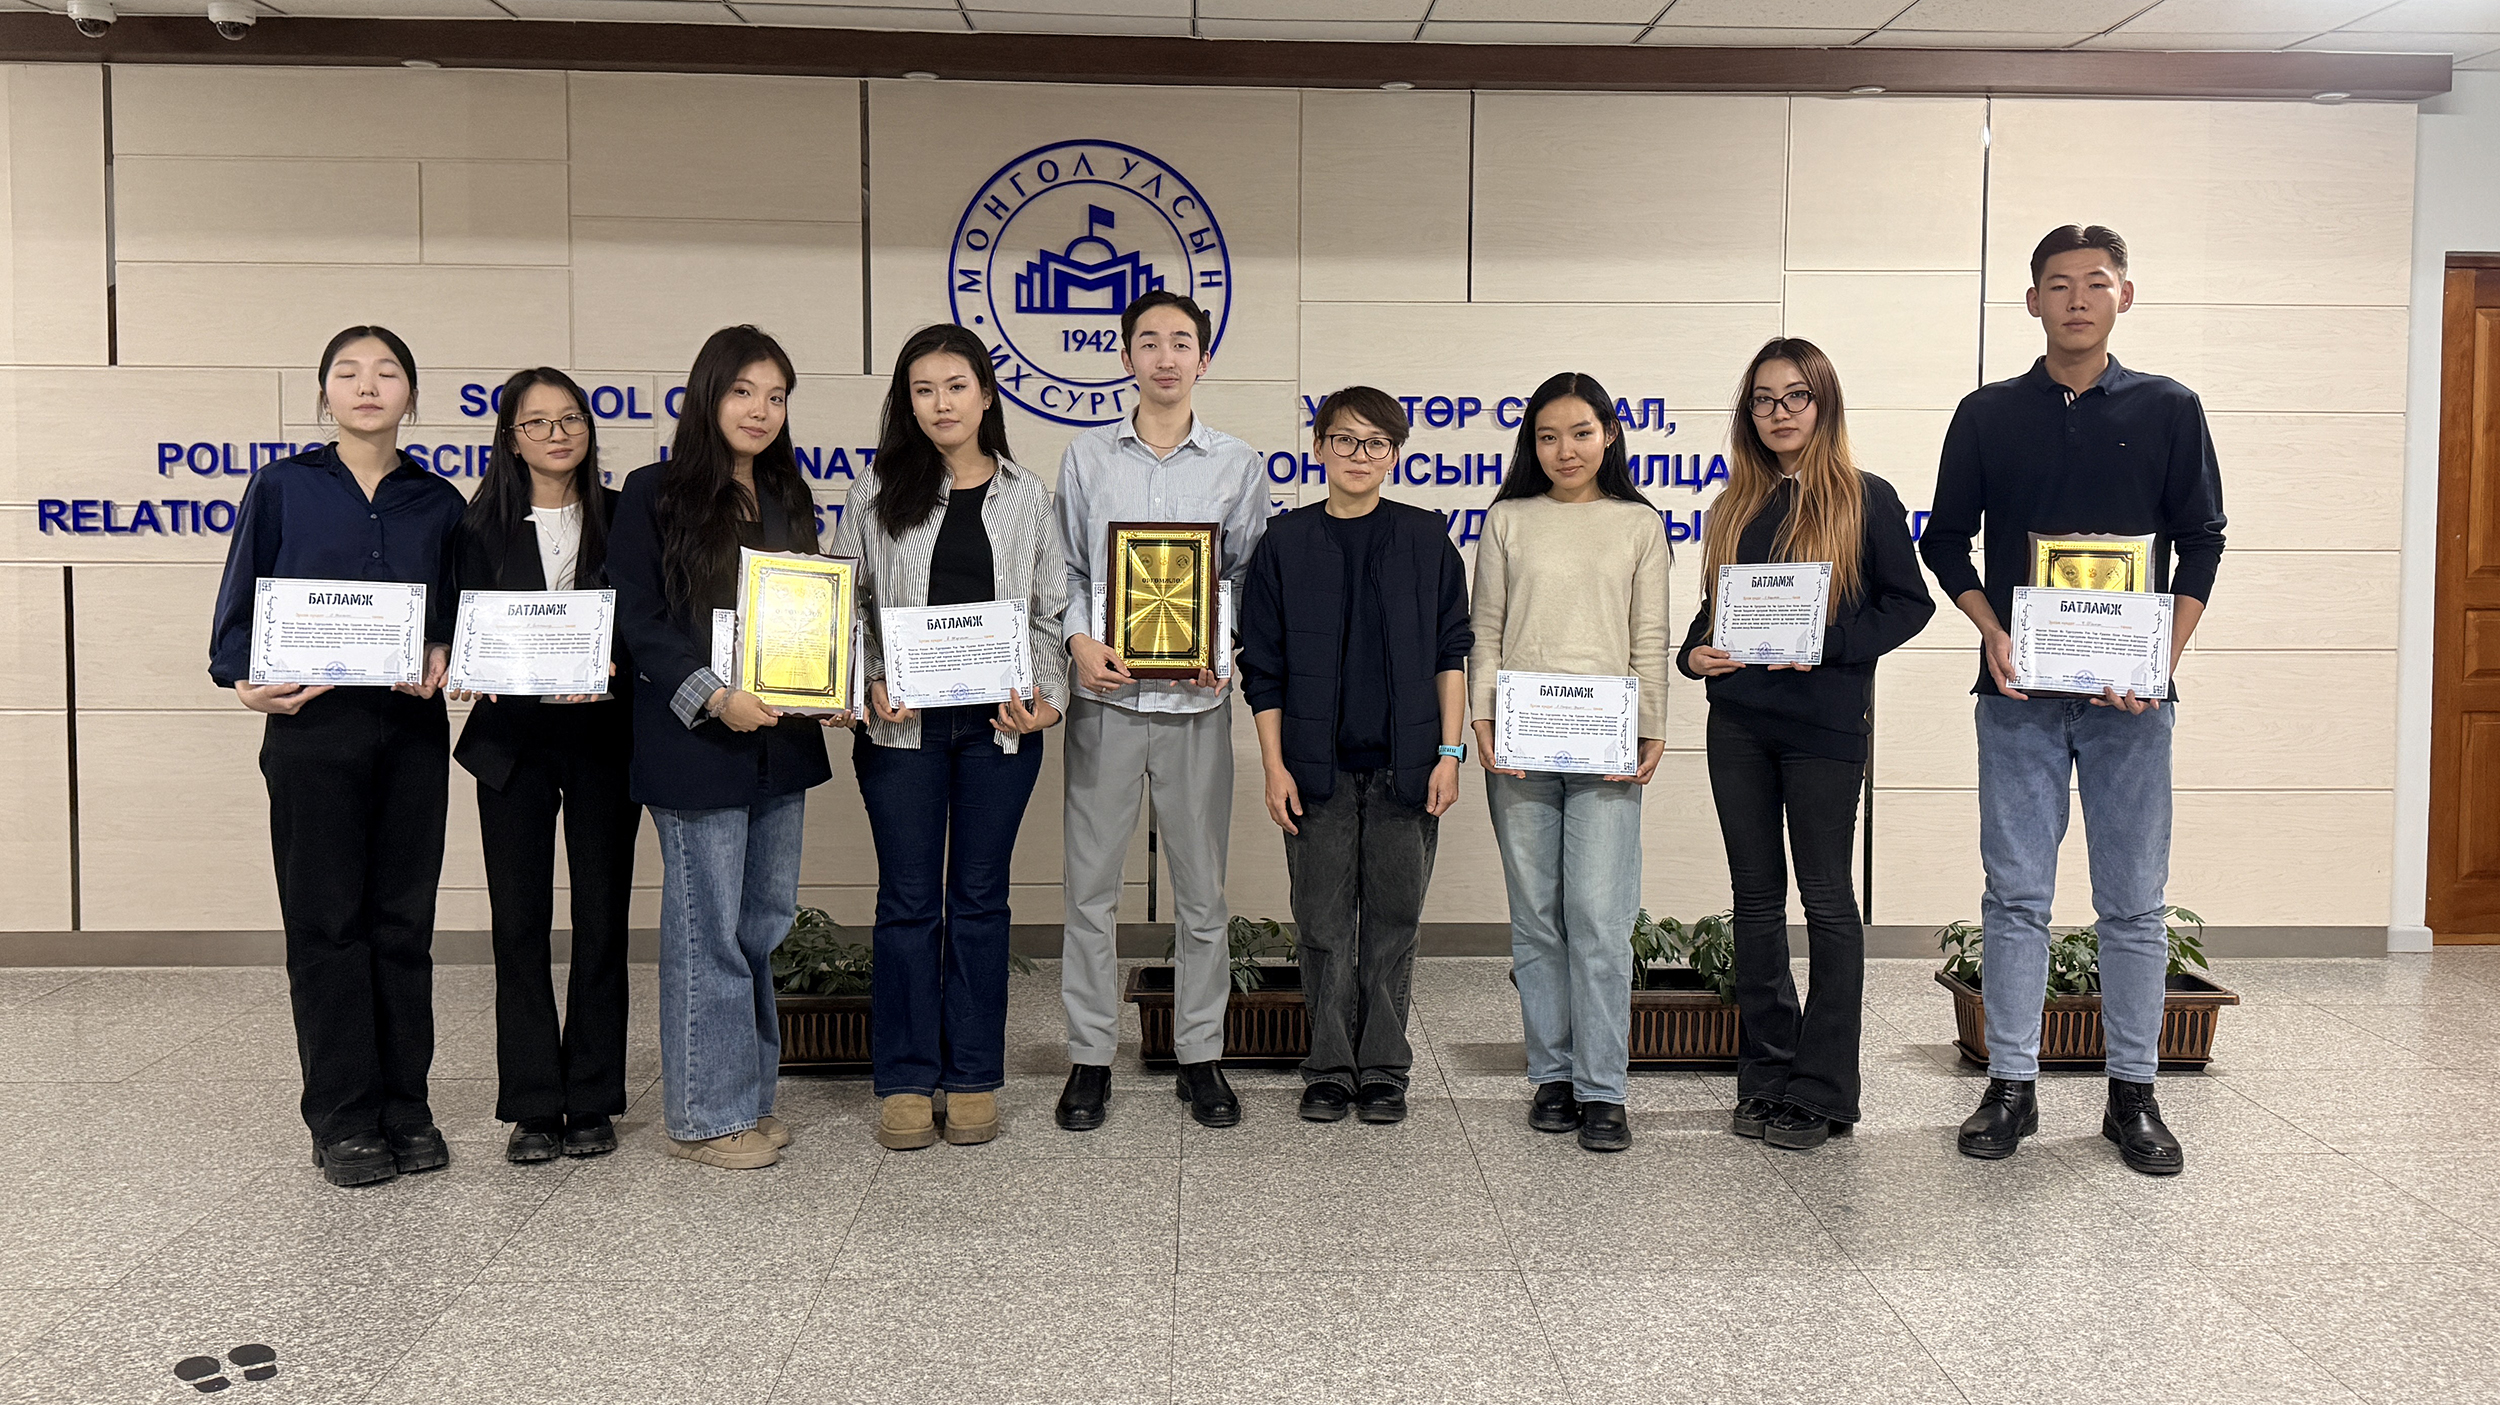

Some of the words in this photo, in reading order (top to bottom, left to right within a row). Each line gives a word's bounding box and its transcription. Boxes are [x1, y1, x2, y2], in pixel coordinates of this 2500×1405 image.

[958, 152, 1095, 292] МОНГОЛ
[1120, 157, 1223, 287] УЛСЫН
[1062, 329, 1117, 352] 1942
[1399, 396, 1482, 428] ТӨР
[1751, 575, 1795, 588] БАТЛАМЖ
[308, 592, 374, 606] БАТЛАМЖ
[507, 603, 567, 616] БАТЛАМЖ
[2060, 600, 2123, 616] БАТЛАМЖ
[927, 615, 984, 631] БАТЛАМЖ
[1539, 684, 1594, 699] БАТЛАМЖ
